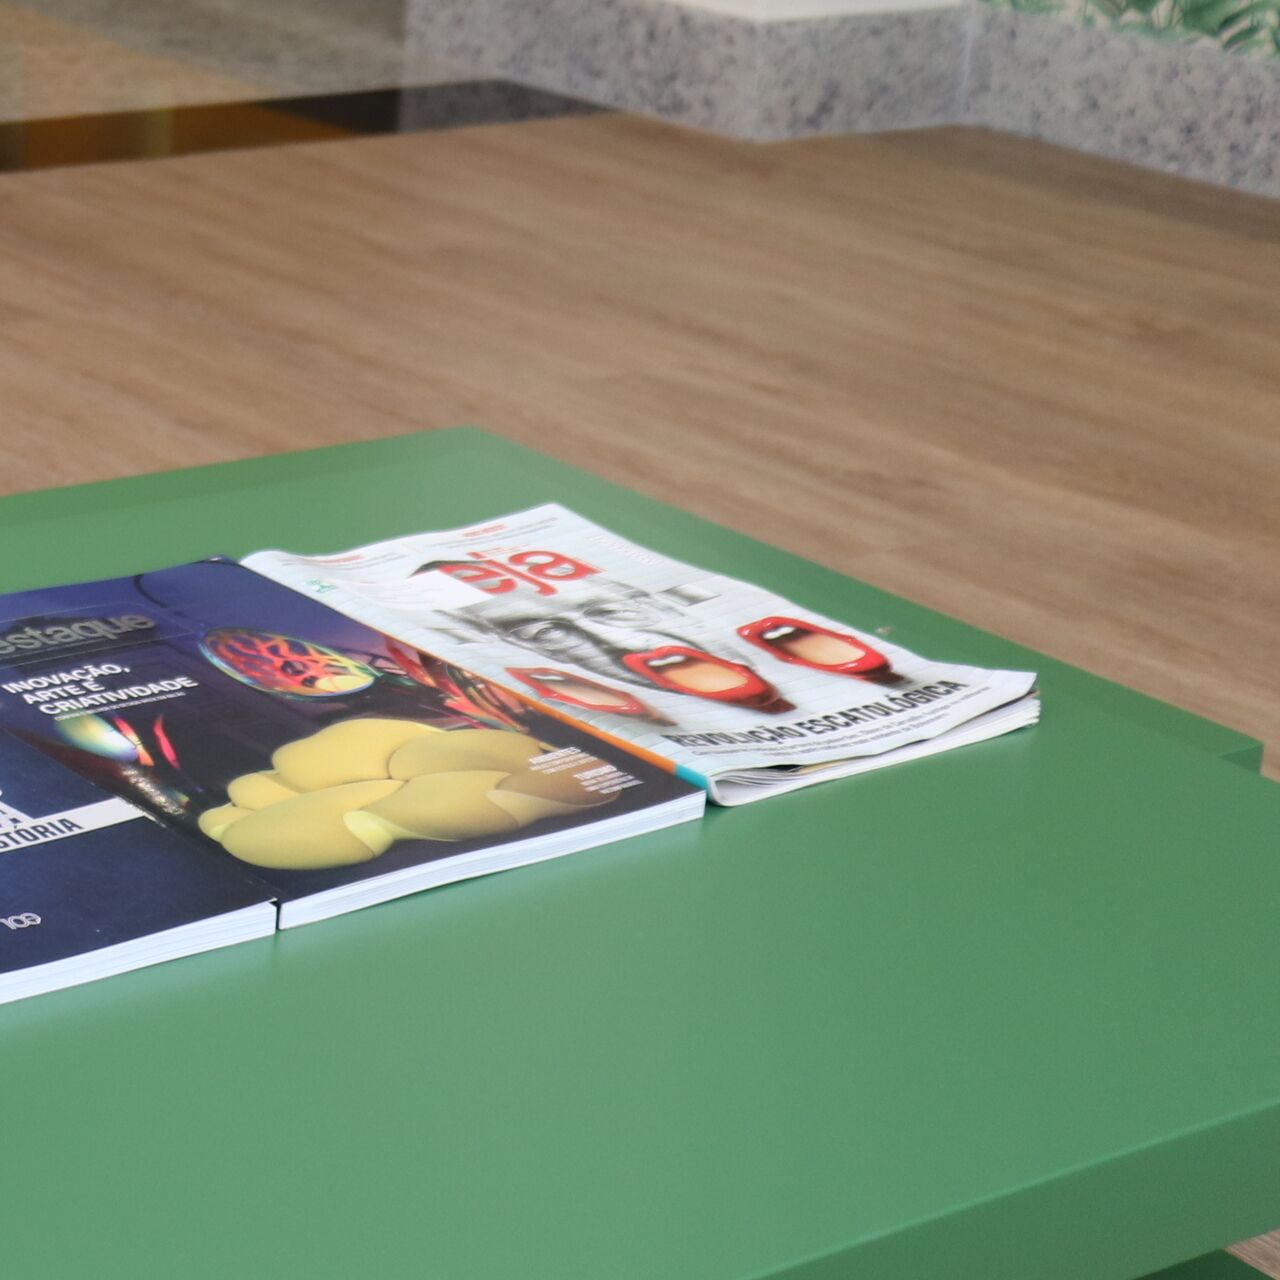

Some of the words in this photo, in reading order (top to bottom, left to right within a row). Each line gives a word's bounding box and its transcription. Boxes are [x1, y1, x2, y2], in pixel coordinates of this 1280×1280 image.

[439, 550, 607, 596] eja
[1, 664, 131, 695] INOVAÇÃO,
[22, 684, 86, 705] ARTE
[81, 680, 106, 693] E
[39, 676, 199, 714] CRIATIVIDADE
[660, 725, 807, 747] REVOLUÇÃO
[797, 680, 969, 736] ESCATOLÓGICA
